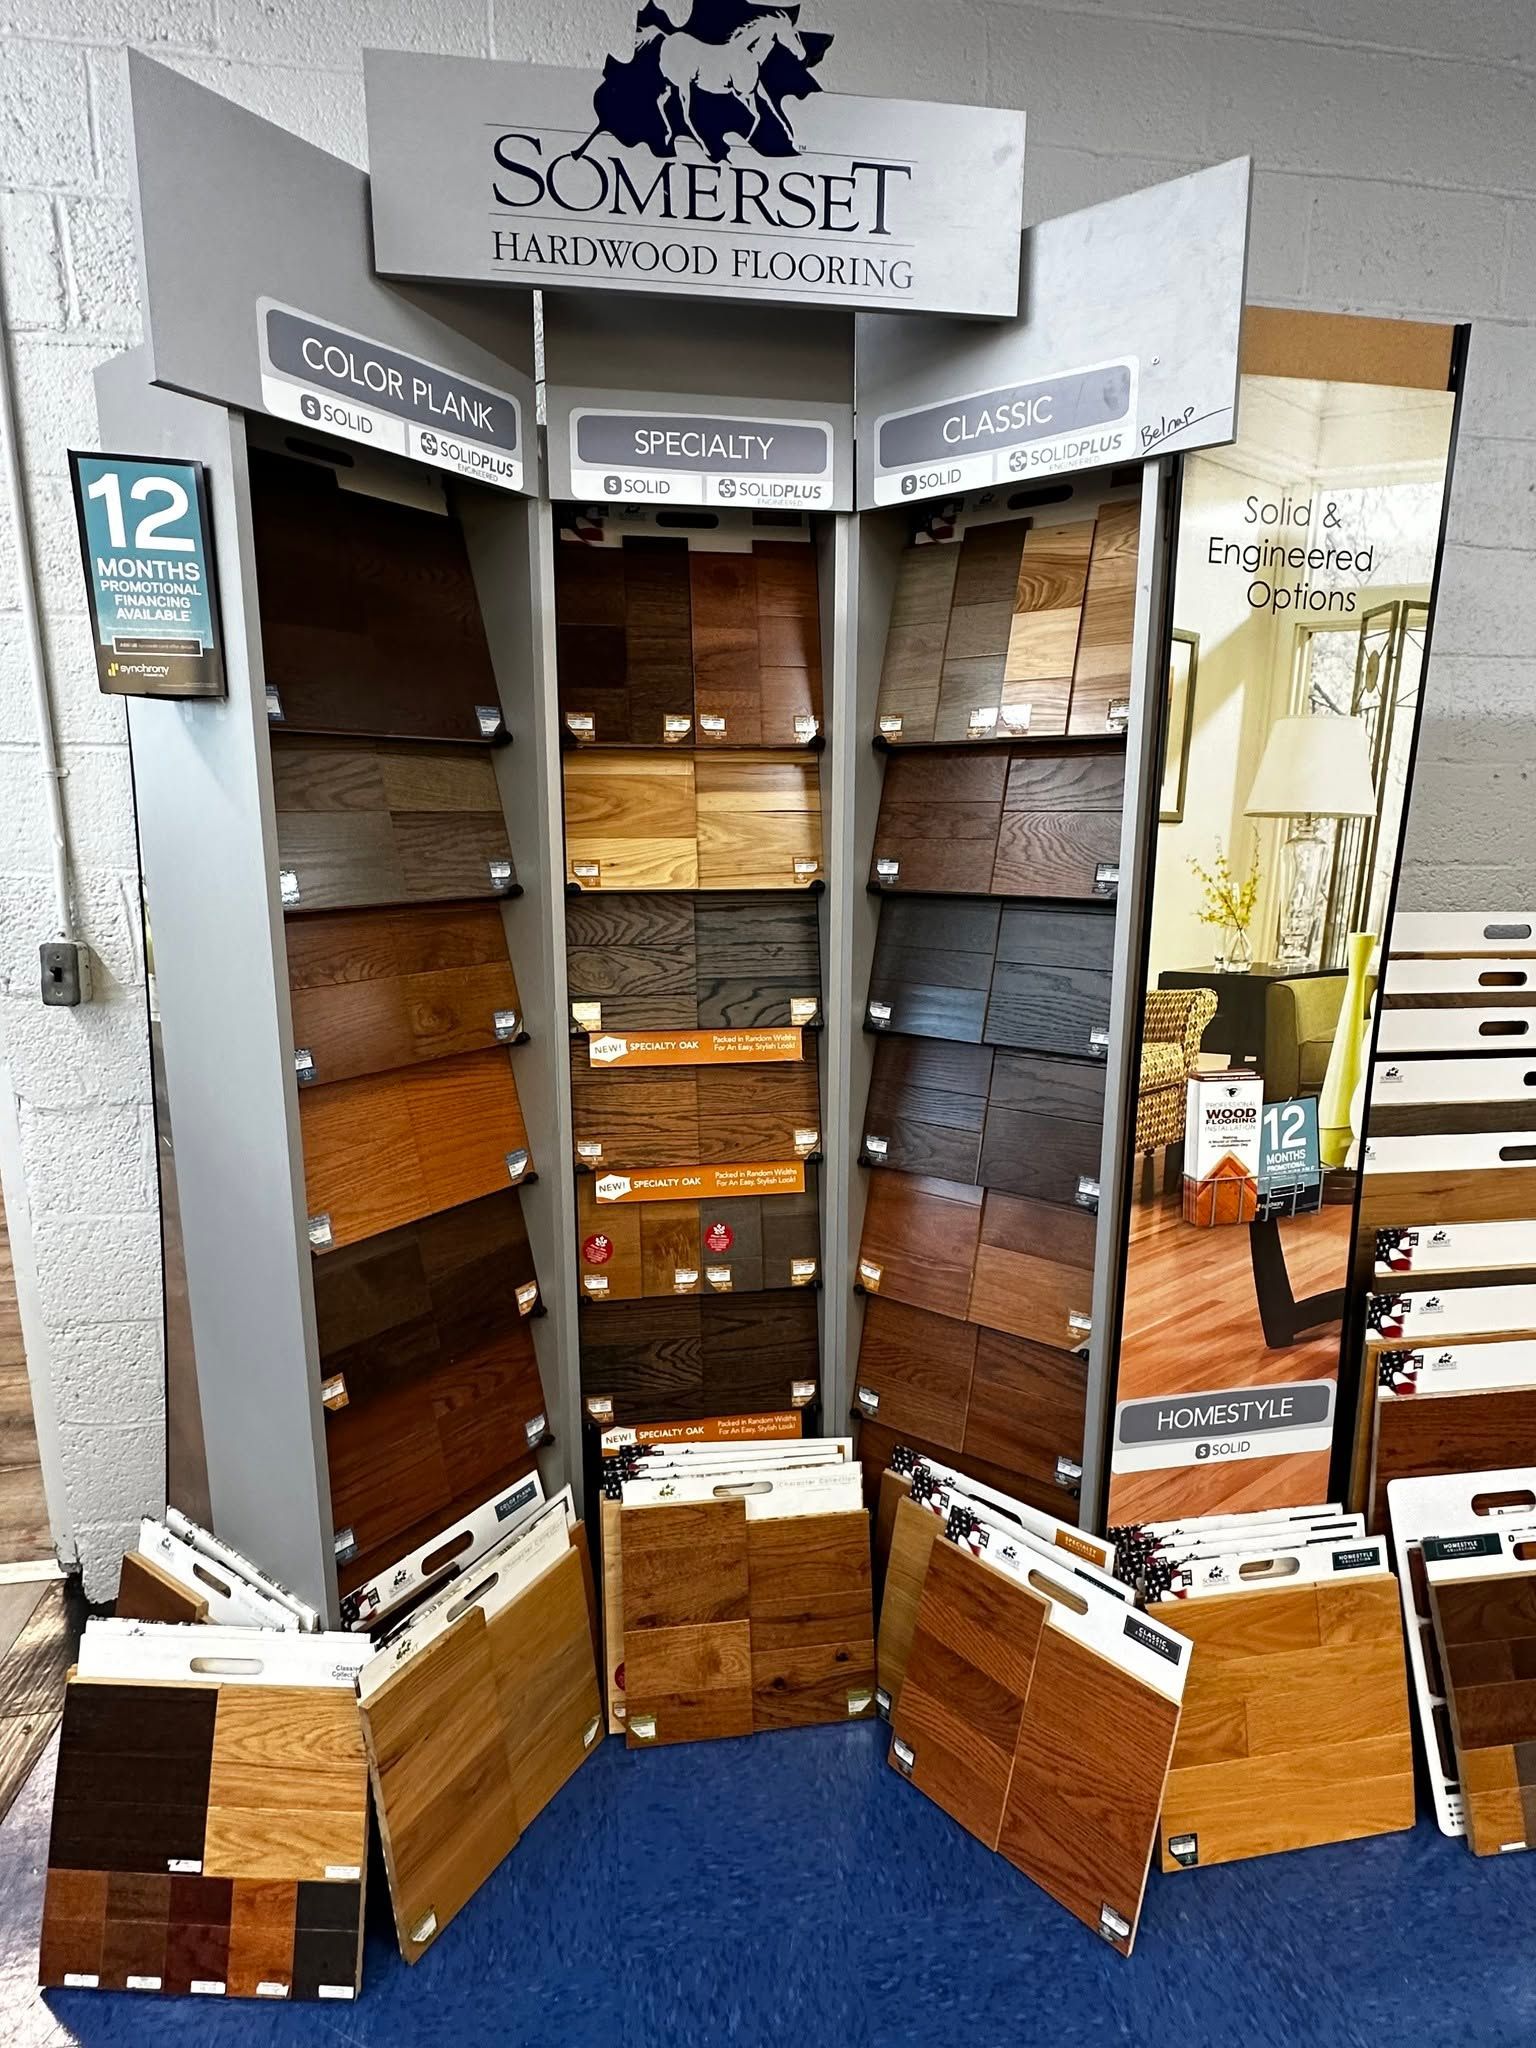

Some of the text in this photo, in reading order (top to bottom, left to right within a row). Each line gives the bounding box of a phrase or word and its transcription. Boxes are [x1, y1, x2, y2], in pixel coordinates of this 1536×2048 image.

[492, 133, 913, 236] SOMERSET
[492, 231, 914, 290] HARDWOOD FLOORING
[302, 337, 494, 433] COLOR PLANK
[324, 404, 373, 434] SOLID
[942, 396, 1053, 444] CLASSIC
[634, 429, 774, 460] SPECIALTY
[1031, 433, 1123, 467] SOLIDPLUS
[440, 441, 514, 478] SOLIDPLUS
[457, 463, 499, 482] ENGINEERED
[919, 469, 962, 490] SOLID
[624, 479, 670, 495] SOLID
[739, 482, 822, 499] SOLIDPLUS
[88, 472, 195, 552] 12
[1244, 495, 1342, 529] Solid &
[1208, 536, 1374, 573] Engineered
[96, 557, 201, 582] MONTHS
[100, 579, 202, 596] PROMOTIONAL
[114, 594, 191, 609] FINANCING
[1247, 580, 1357, 615] Options
[116, 606, 192, 622] AVAILABLE
[120, 663, 170, 676] synchrony
[594, 1041, 699, 1055] NEW! SPECIALTY OAK
[756, 1043, 776, 1051] Stylish
[1205, 1108, 1257, 1119] WOOD
[1263, 1105, 1307, 1151] 12
[1266, 1149, 1306, 1165] MONTHS
[1266, 1160, 1306, 1172] PROMOTIONAL
[598, 1177, 702, 1193] NEW! SPECIALTY OAK
[757, 1177, 777, 1186] Stylish
[1157, 1397, 1294, 1431] HOMESTYLE
[606, 1426, 705, 1444] NEW! SPECIALTY OAK
[1212, 1441, 1251, 1456] SOLID
[1065, 1536, 1097, 1554] SPECIALTY
[1443, 1540, 1478, 1549] HOMESTYLE
[1339, 1552, 1373, 1560] HOMESTYLE
[1139, 1627, 1168, 1648] CLASSIC
